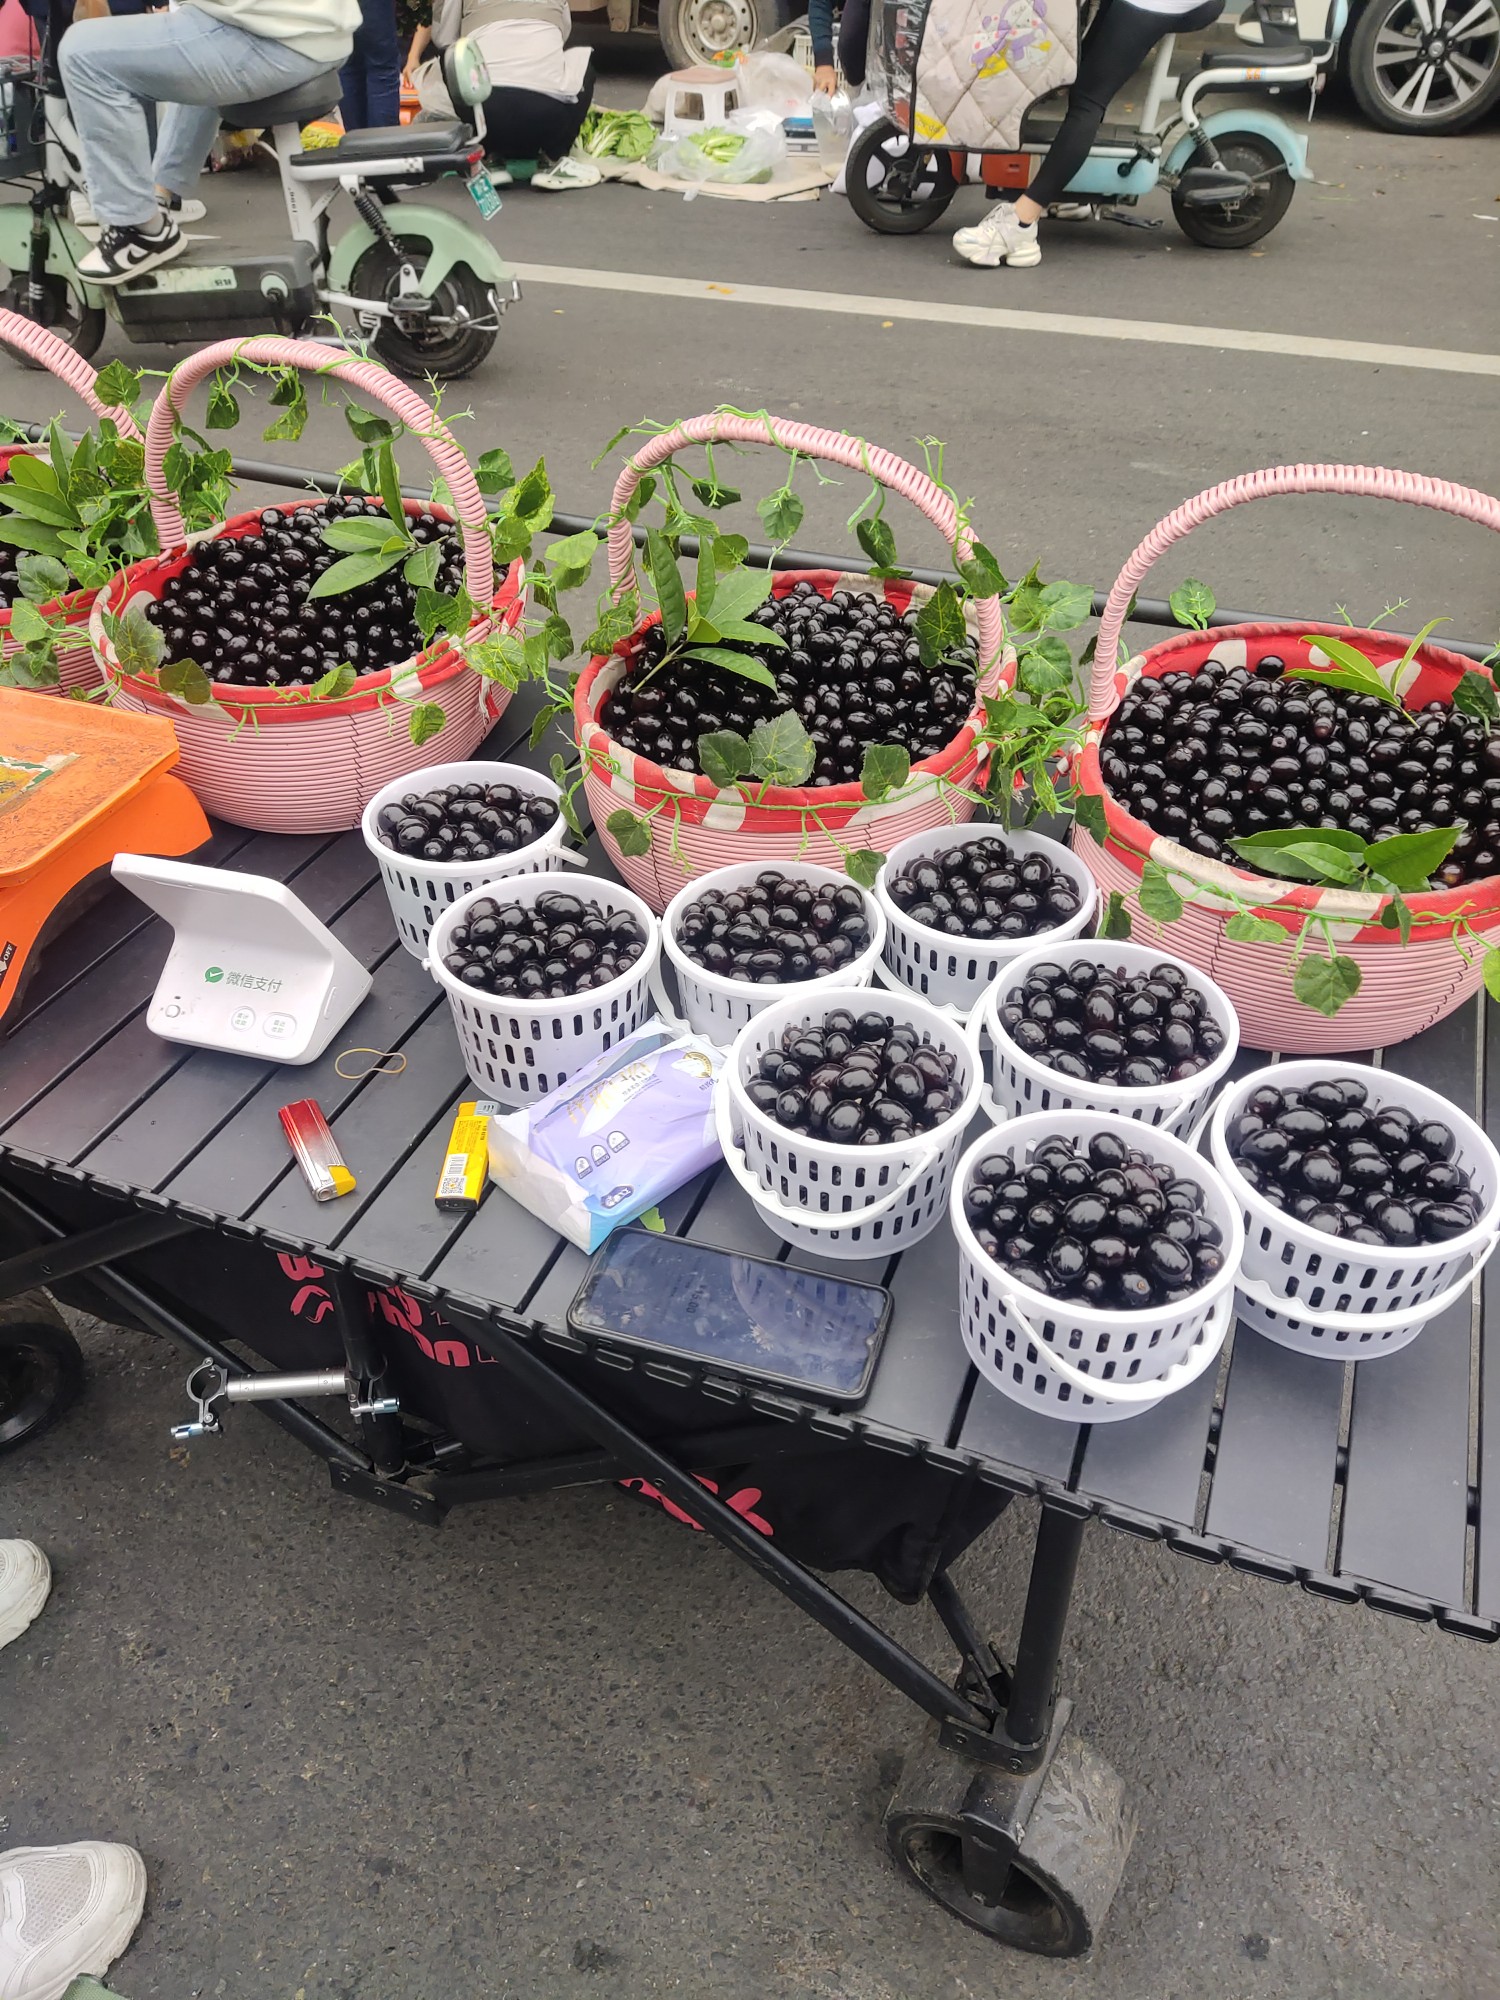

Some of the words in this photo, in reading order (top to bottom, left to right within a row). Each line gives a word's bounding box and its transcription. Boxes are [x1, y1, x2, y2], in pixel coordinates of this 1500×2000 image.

[3, 944, 12, 961] OFF
[226, 971, 283, 993] 微信支付
